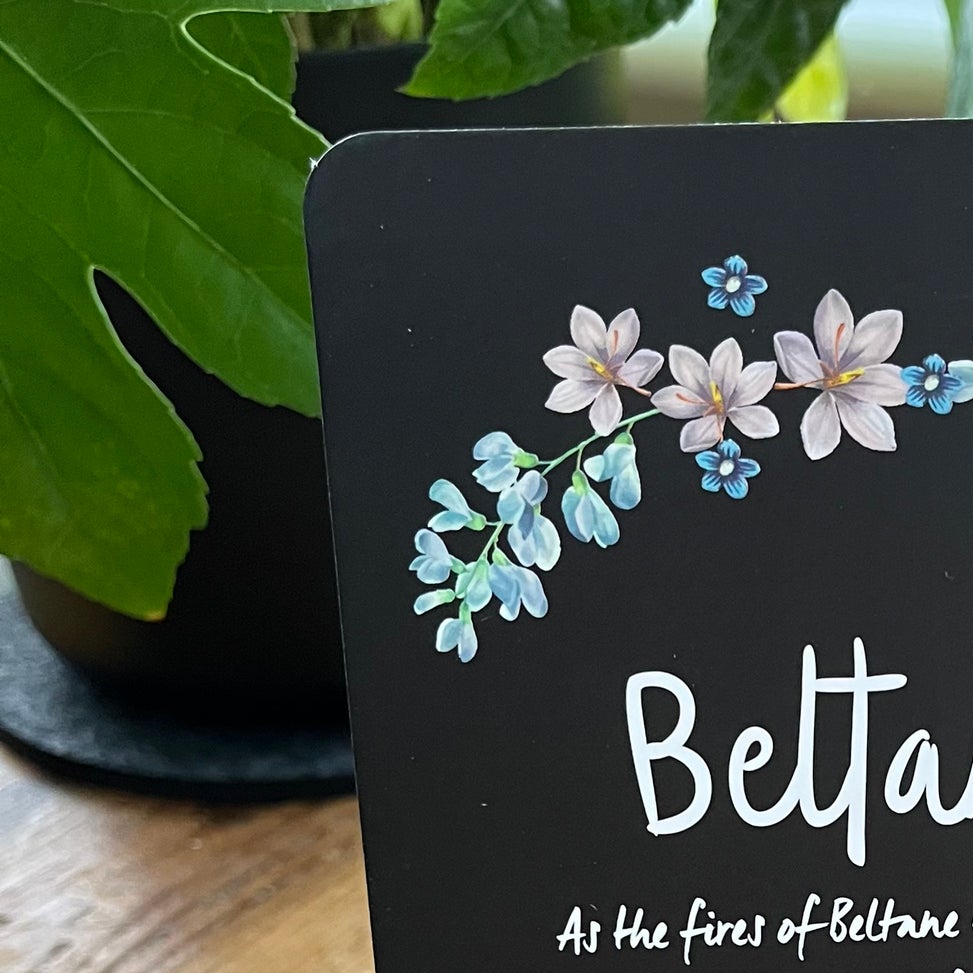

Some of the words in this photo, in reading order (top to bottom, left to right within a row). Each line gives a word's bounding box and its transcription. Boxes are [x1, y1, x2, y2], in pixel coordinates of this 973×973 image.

[556, 904, 600, 955] As
[613, 904, 669, 949] the
[680, 898, 765, 965] fires
[777, 893, 829, 961] of
[830, 897, 959, 942] Beltane
